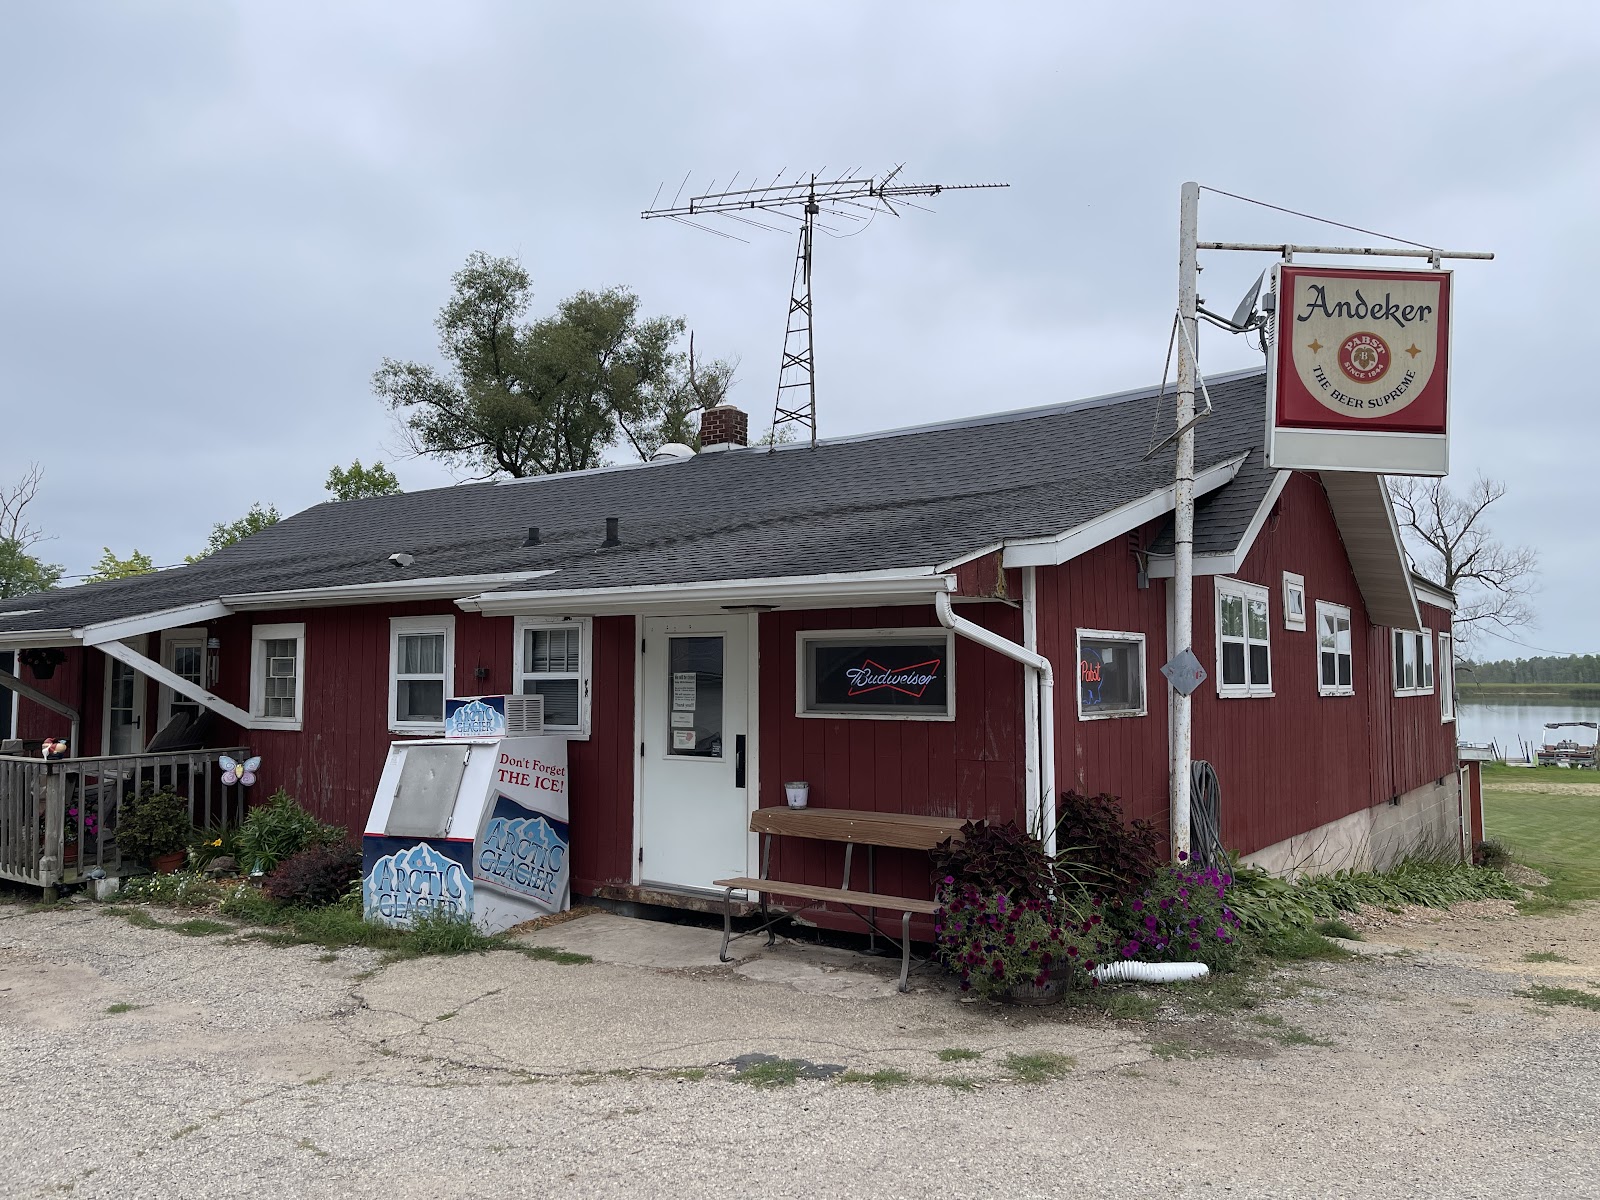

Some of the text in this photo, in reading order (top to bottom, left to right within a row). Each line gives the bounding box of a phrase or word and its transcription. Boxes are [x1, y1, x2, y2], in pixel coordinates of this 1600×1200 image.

[1297, 284, 1432, 328] Andeker
[1345, 336, 1385, 354] PABST
[1344, 361, 1384, 378] SINCE 1844
[1312, 365, 1416, 409] THE BEER SUPREME
[846, 668, 937, 687] Budweiser
[1081, 660, 1101, 682] Pabst
[456, 706, 493, 722] ARCTIC
[456, 721, 494, 733] GLACIER
[499, 753, 566, 777] Don't Forget
[497, 769, 565, 794] THE ICE!
[483, 821, 565, 873] ARCTIC
[377, 859, 462, 899] ARCTIC
[478, 849, 555, 895] GLACIER
